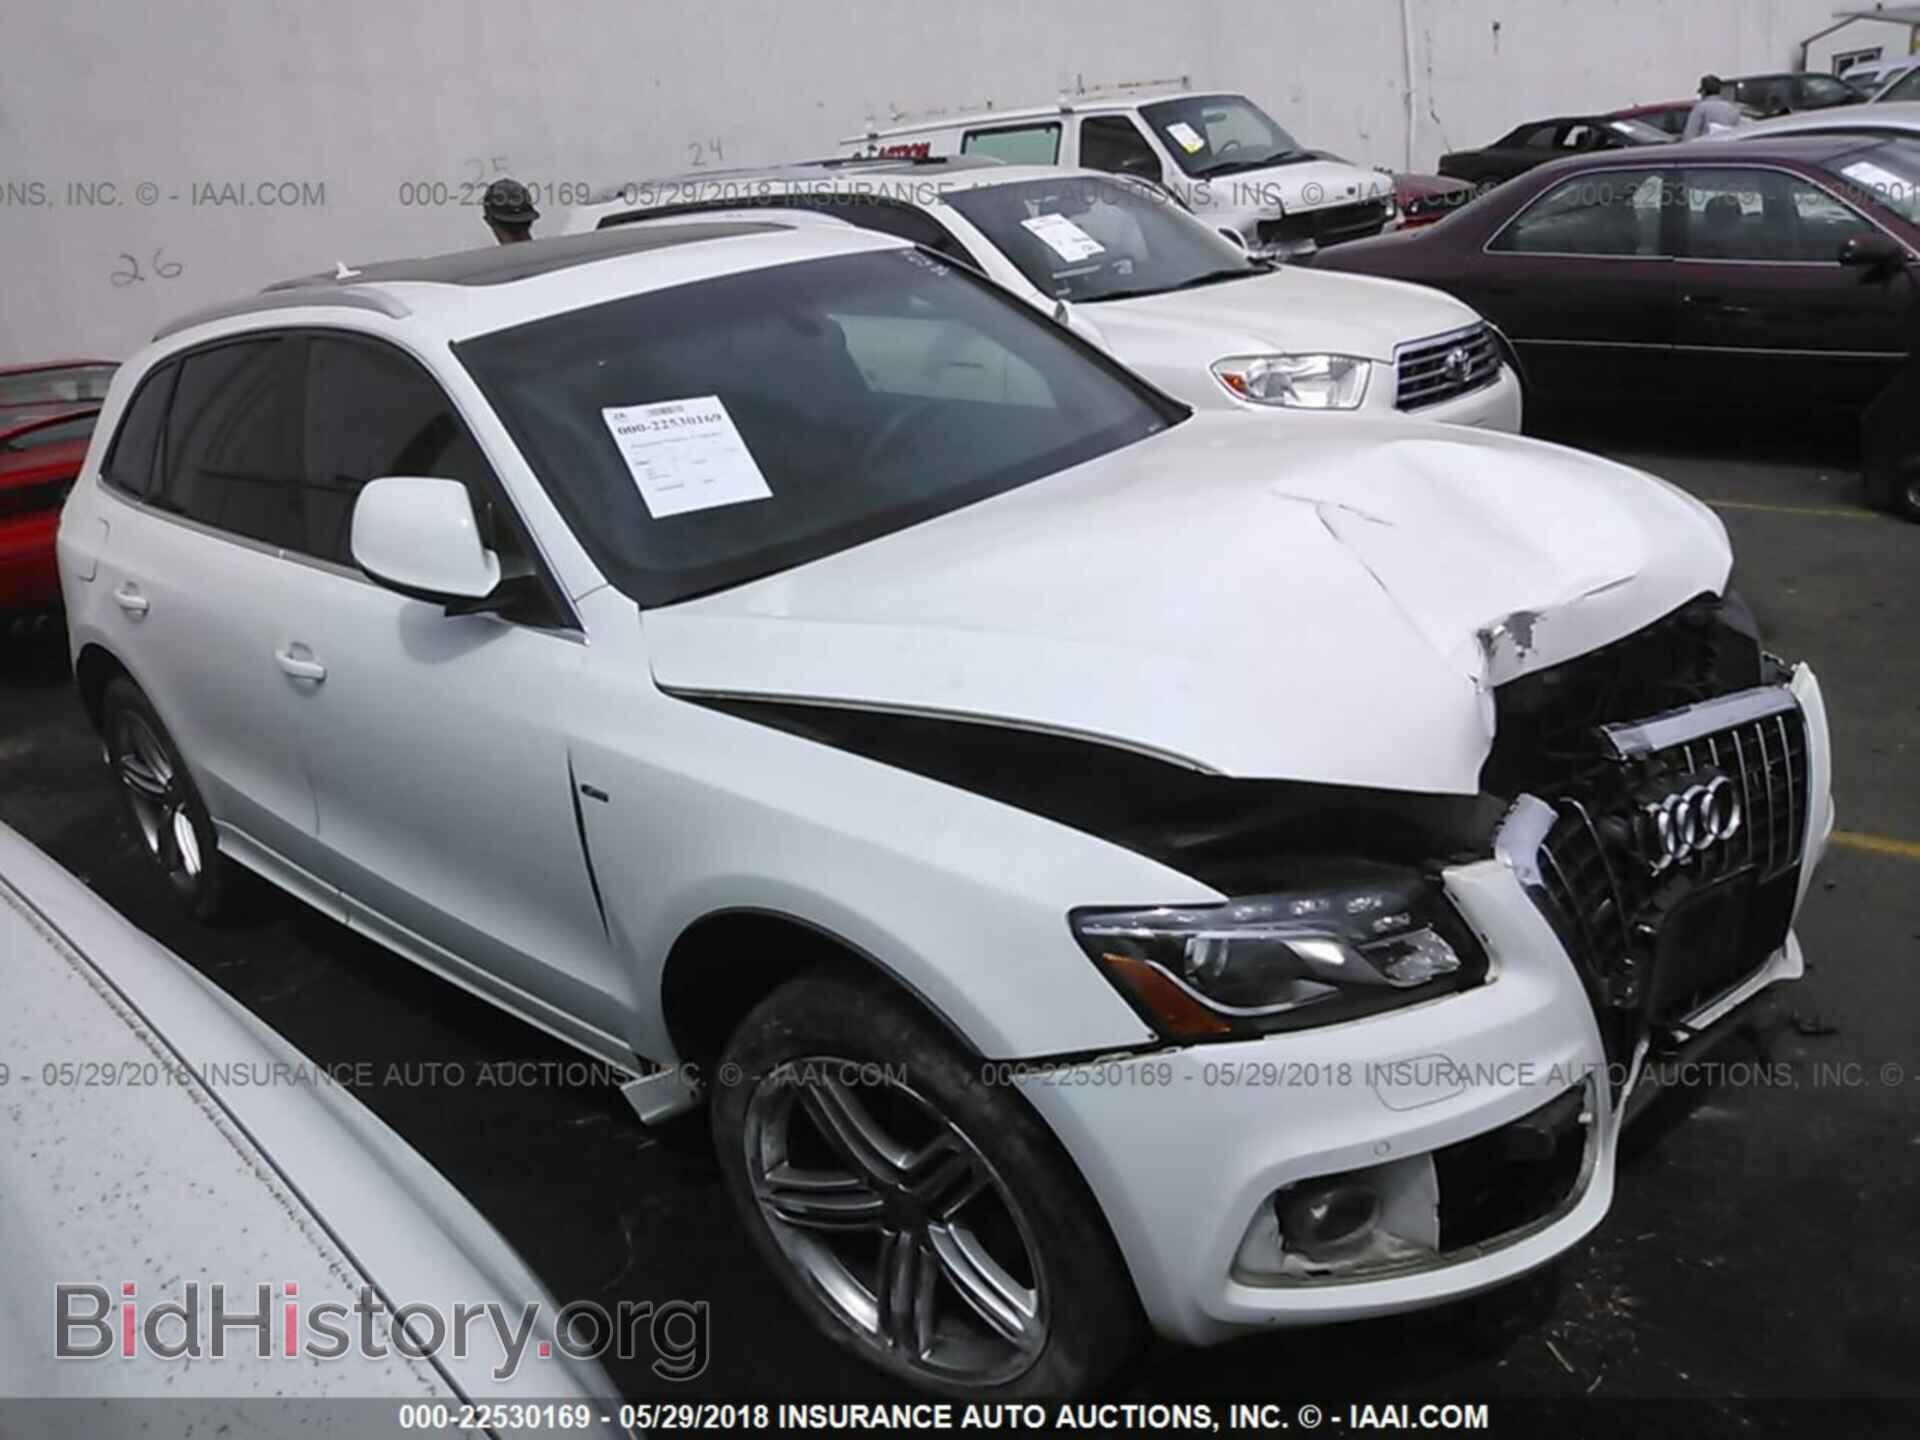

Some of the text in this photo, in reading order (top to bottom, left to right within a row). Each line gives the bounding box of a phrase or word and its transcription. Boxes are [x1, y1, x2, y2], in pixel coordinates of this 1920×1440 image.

[688, 139, 723, 167] 24
[109, 248, 183, 287] 26
[617, 412, 722, 436] 000-22530169
